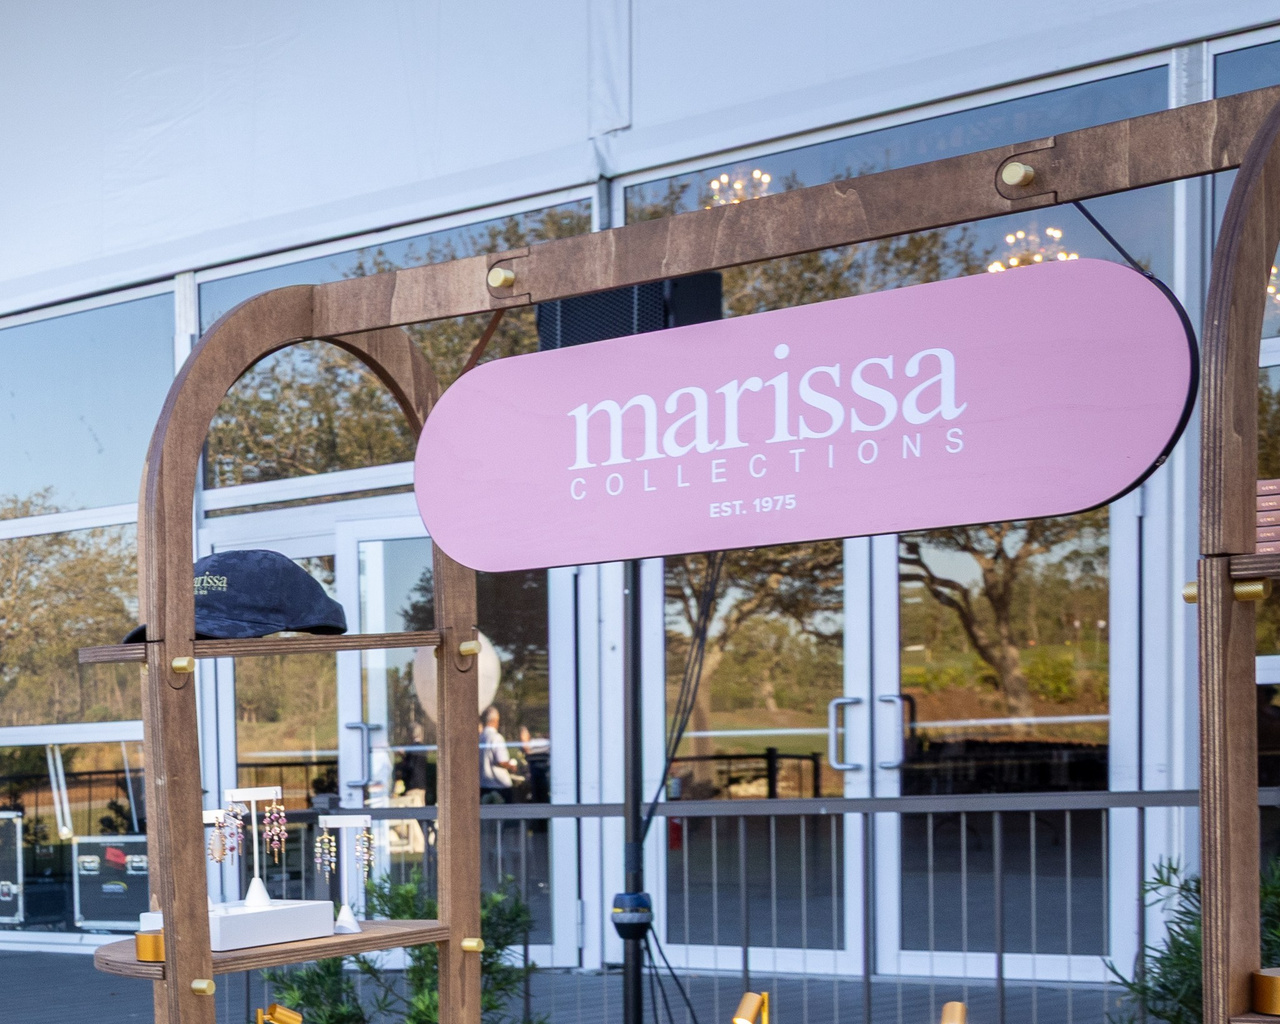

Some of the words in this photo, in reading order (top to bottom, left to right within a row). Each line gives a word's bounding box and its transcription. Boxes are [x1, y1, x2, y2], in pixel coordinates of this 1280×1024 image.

[567, 343, 968, 470] marissa
[570, 428, 964, 500] COLLECTIONS
[709, 500, 747, 518] EST.
[752, 494, 797, 513] 1975
[193, 571, 228, 587] arissa
